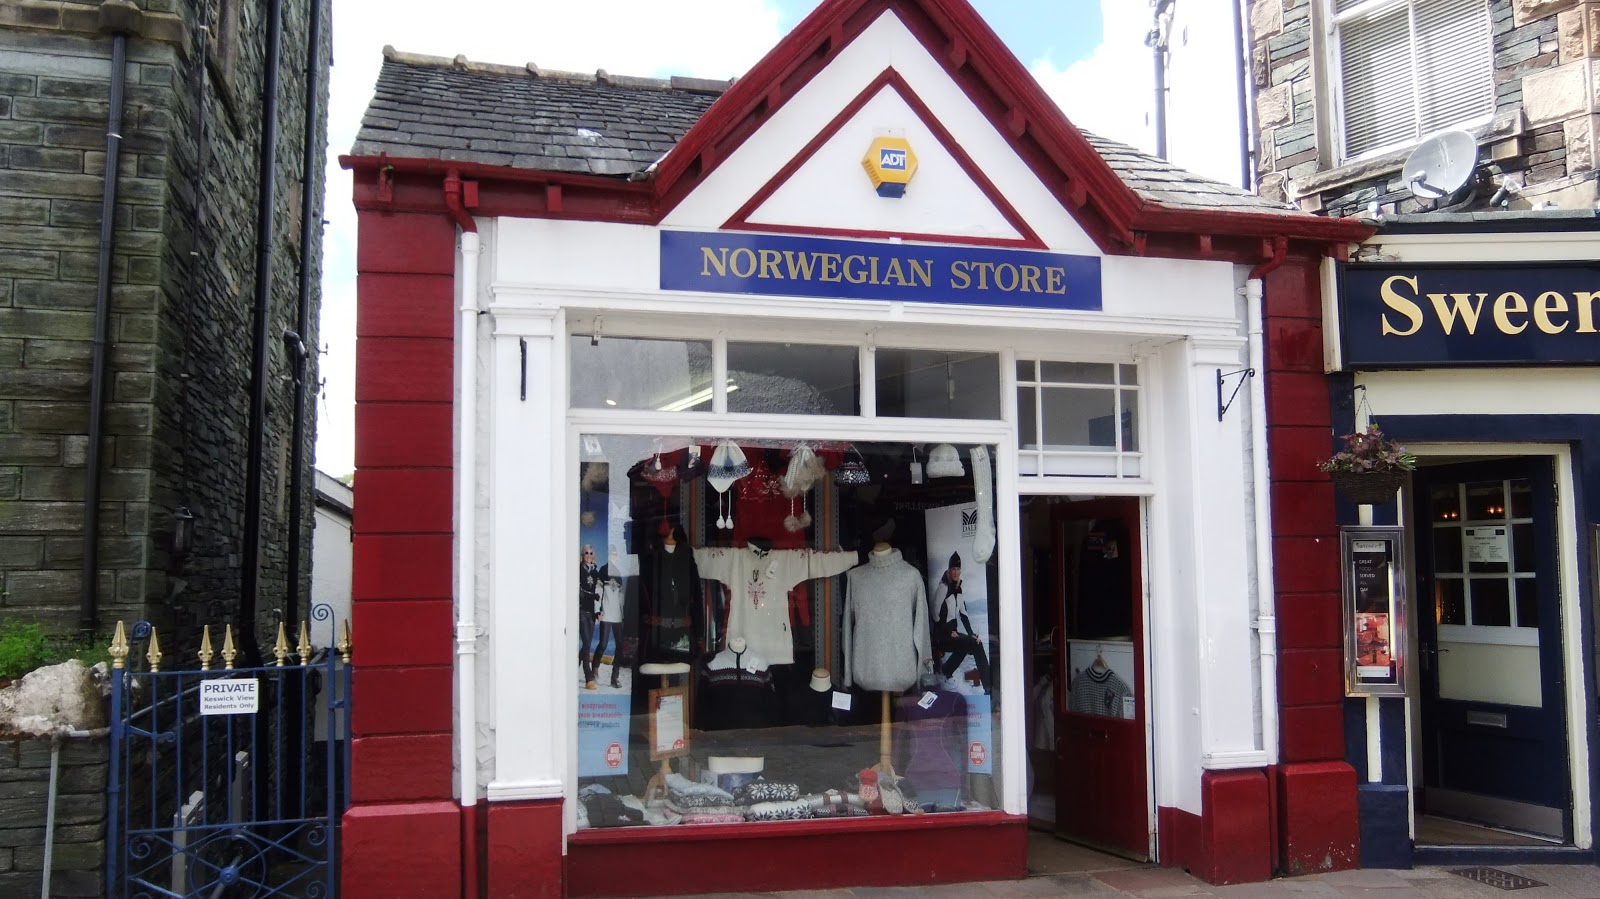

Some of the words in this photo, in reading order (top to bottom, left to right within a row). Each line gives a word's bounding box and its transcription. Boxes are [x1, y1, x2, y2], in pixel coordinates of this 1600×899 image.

[881, 153, 906, 167] ADT
[700, 246, 933, 288] NORWEGIAN
[950, 260, 1067, 295] STORE
[204, 683, 255, 694] PRIVATE
